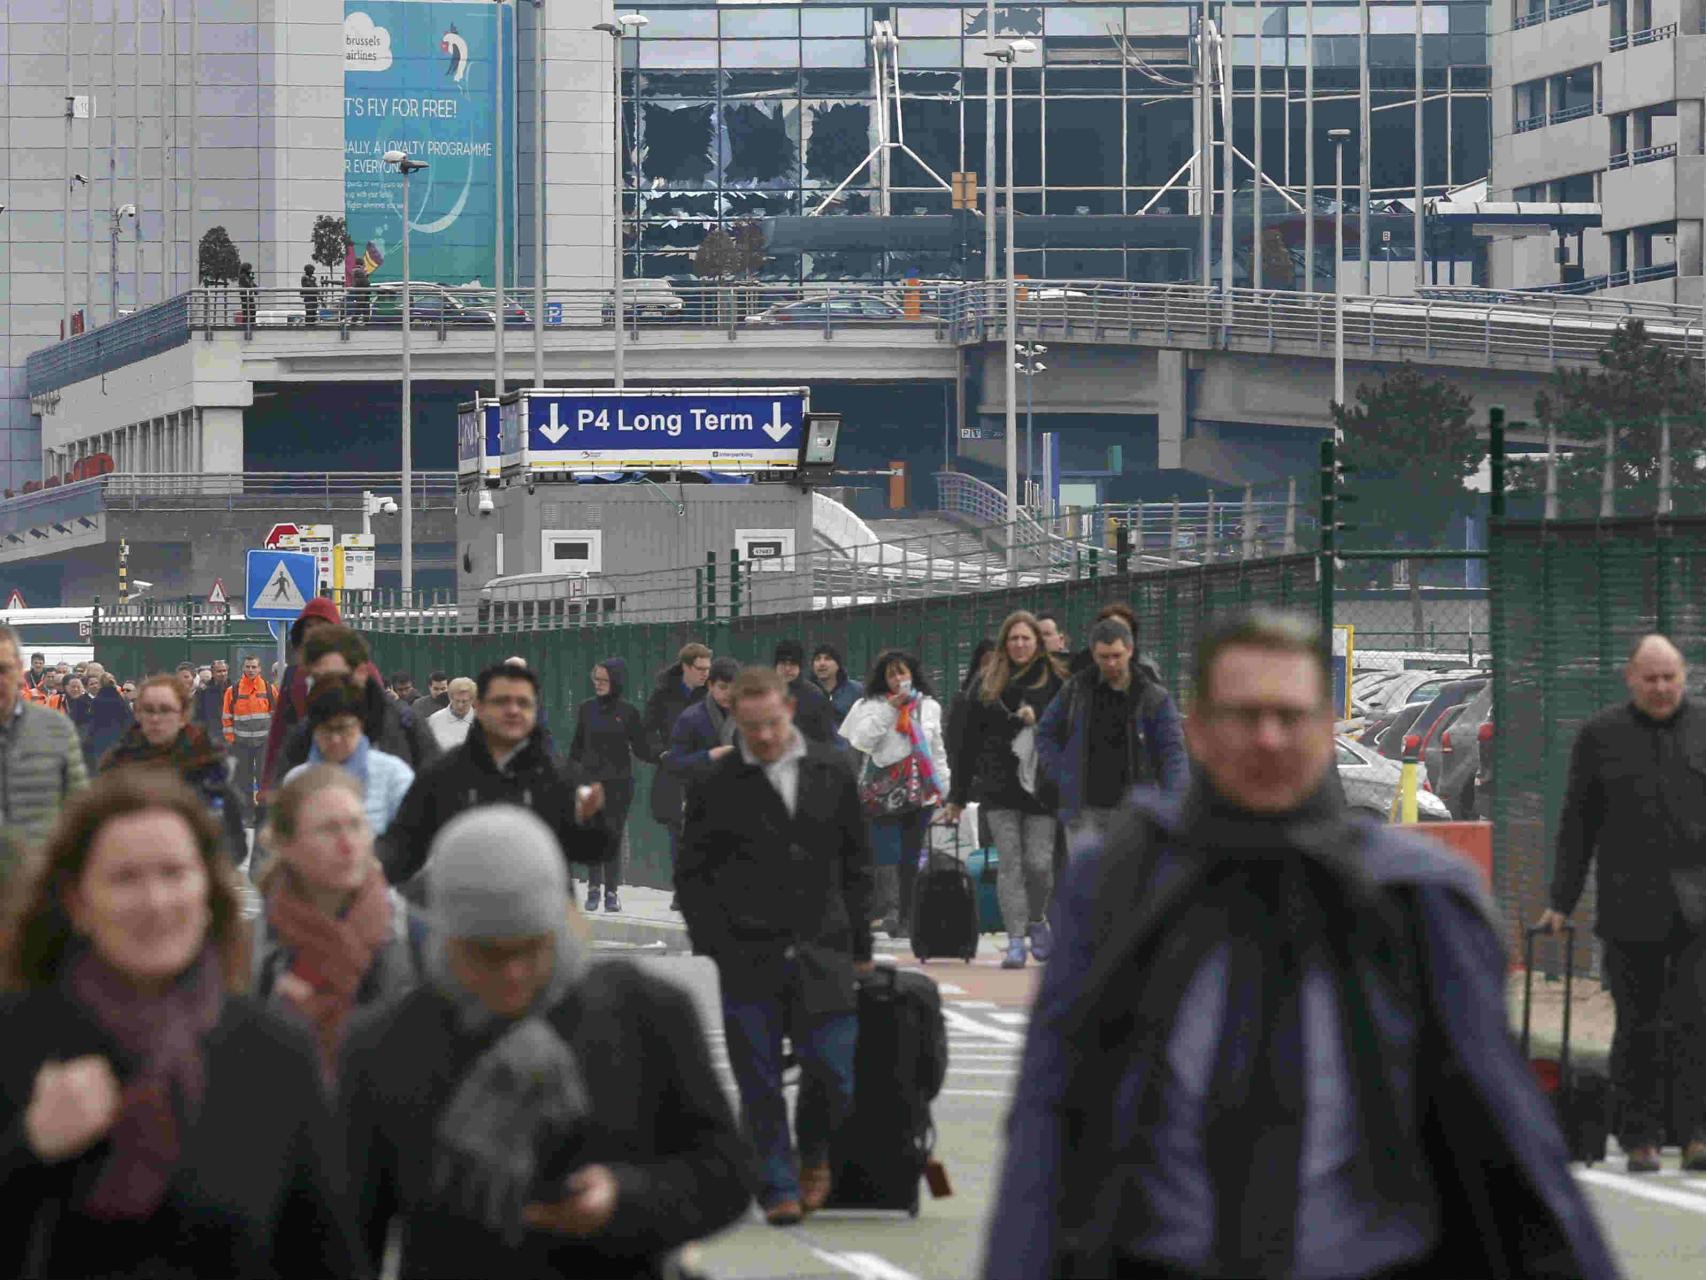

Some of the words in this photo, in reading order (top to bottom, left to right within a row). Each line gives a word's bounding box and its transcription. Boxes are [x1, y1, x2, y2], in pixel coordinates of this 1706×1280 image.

[346, 35, 381, 46] brussels
[346, 50, 377, 61] airlines
[367, 98, 388, 117] FLY
[391, 98, 419, 118] FOR
[422, 98, 457, 118] FREE!
[374, 140, 381, 154] A
[384, 140, 425, 155] LOYALTY
[427, 141, 492, 157] PROGRAMME
[354, 159, 402, 173] EVERYON
[578, 409, 610, 431] P4
[618, 409, 682, 436] Long
[690, 408, 753, 431] Term
